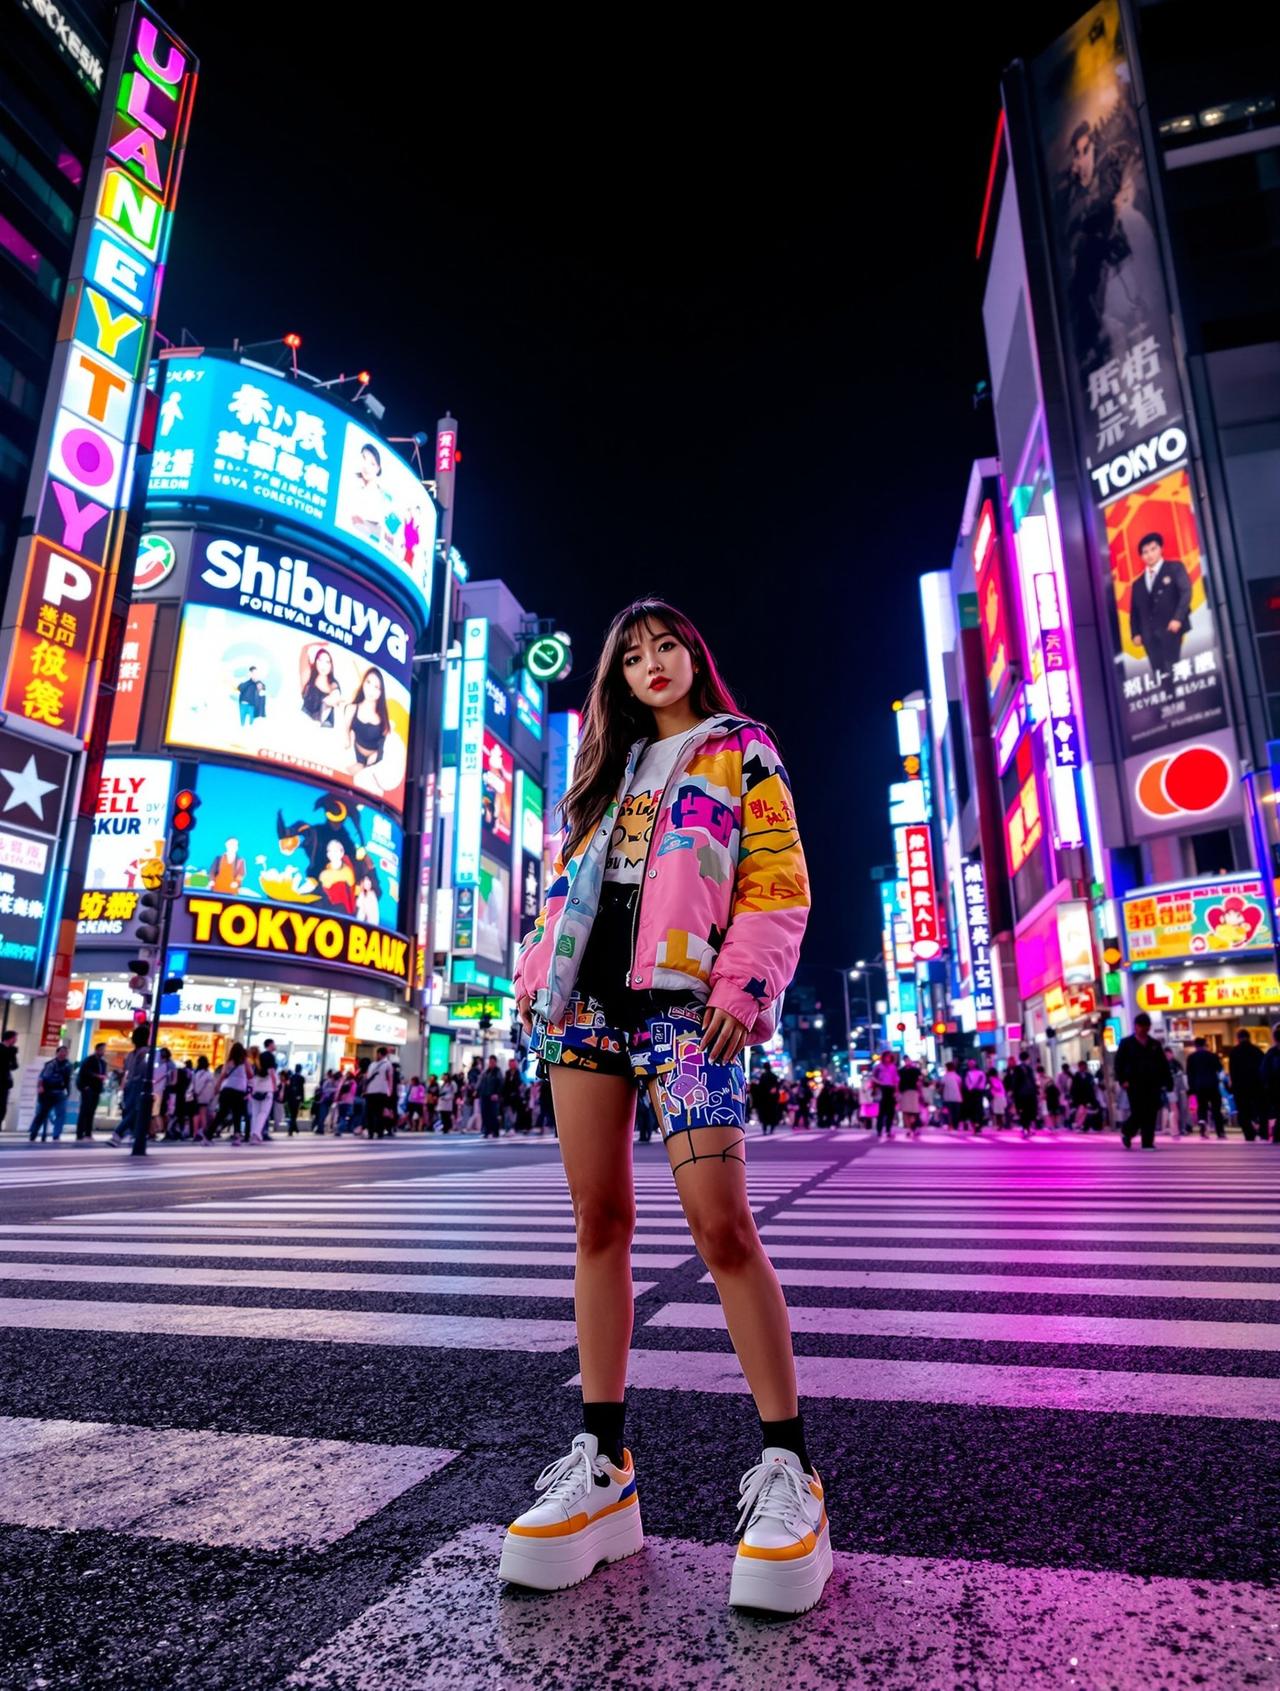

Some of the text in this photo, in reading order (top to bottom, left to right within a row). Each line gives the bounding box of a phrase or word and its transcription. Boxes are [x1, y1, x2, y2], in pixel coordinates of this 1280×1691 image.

[1091, 427, 1187, 497] TOKYO
[43, 552, 92, 607] P
[201, 539, 410, 664] Shibuyya
[188, 899, 344, 959] TOKYO
[348, 925, 407, 976] BANK
